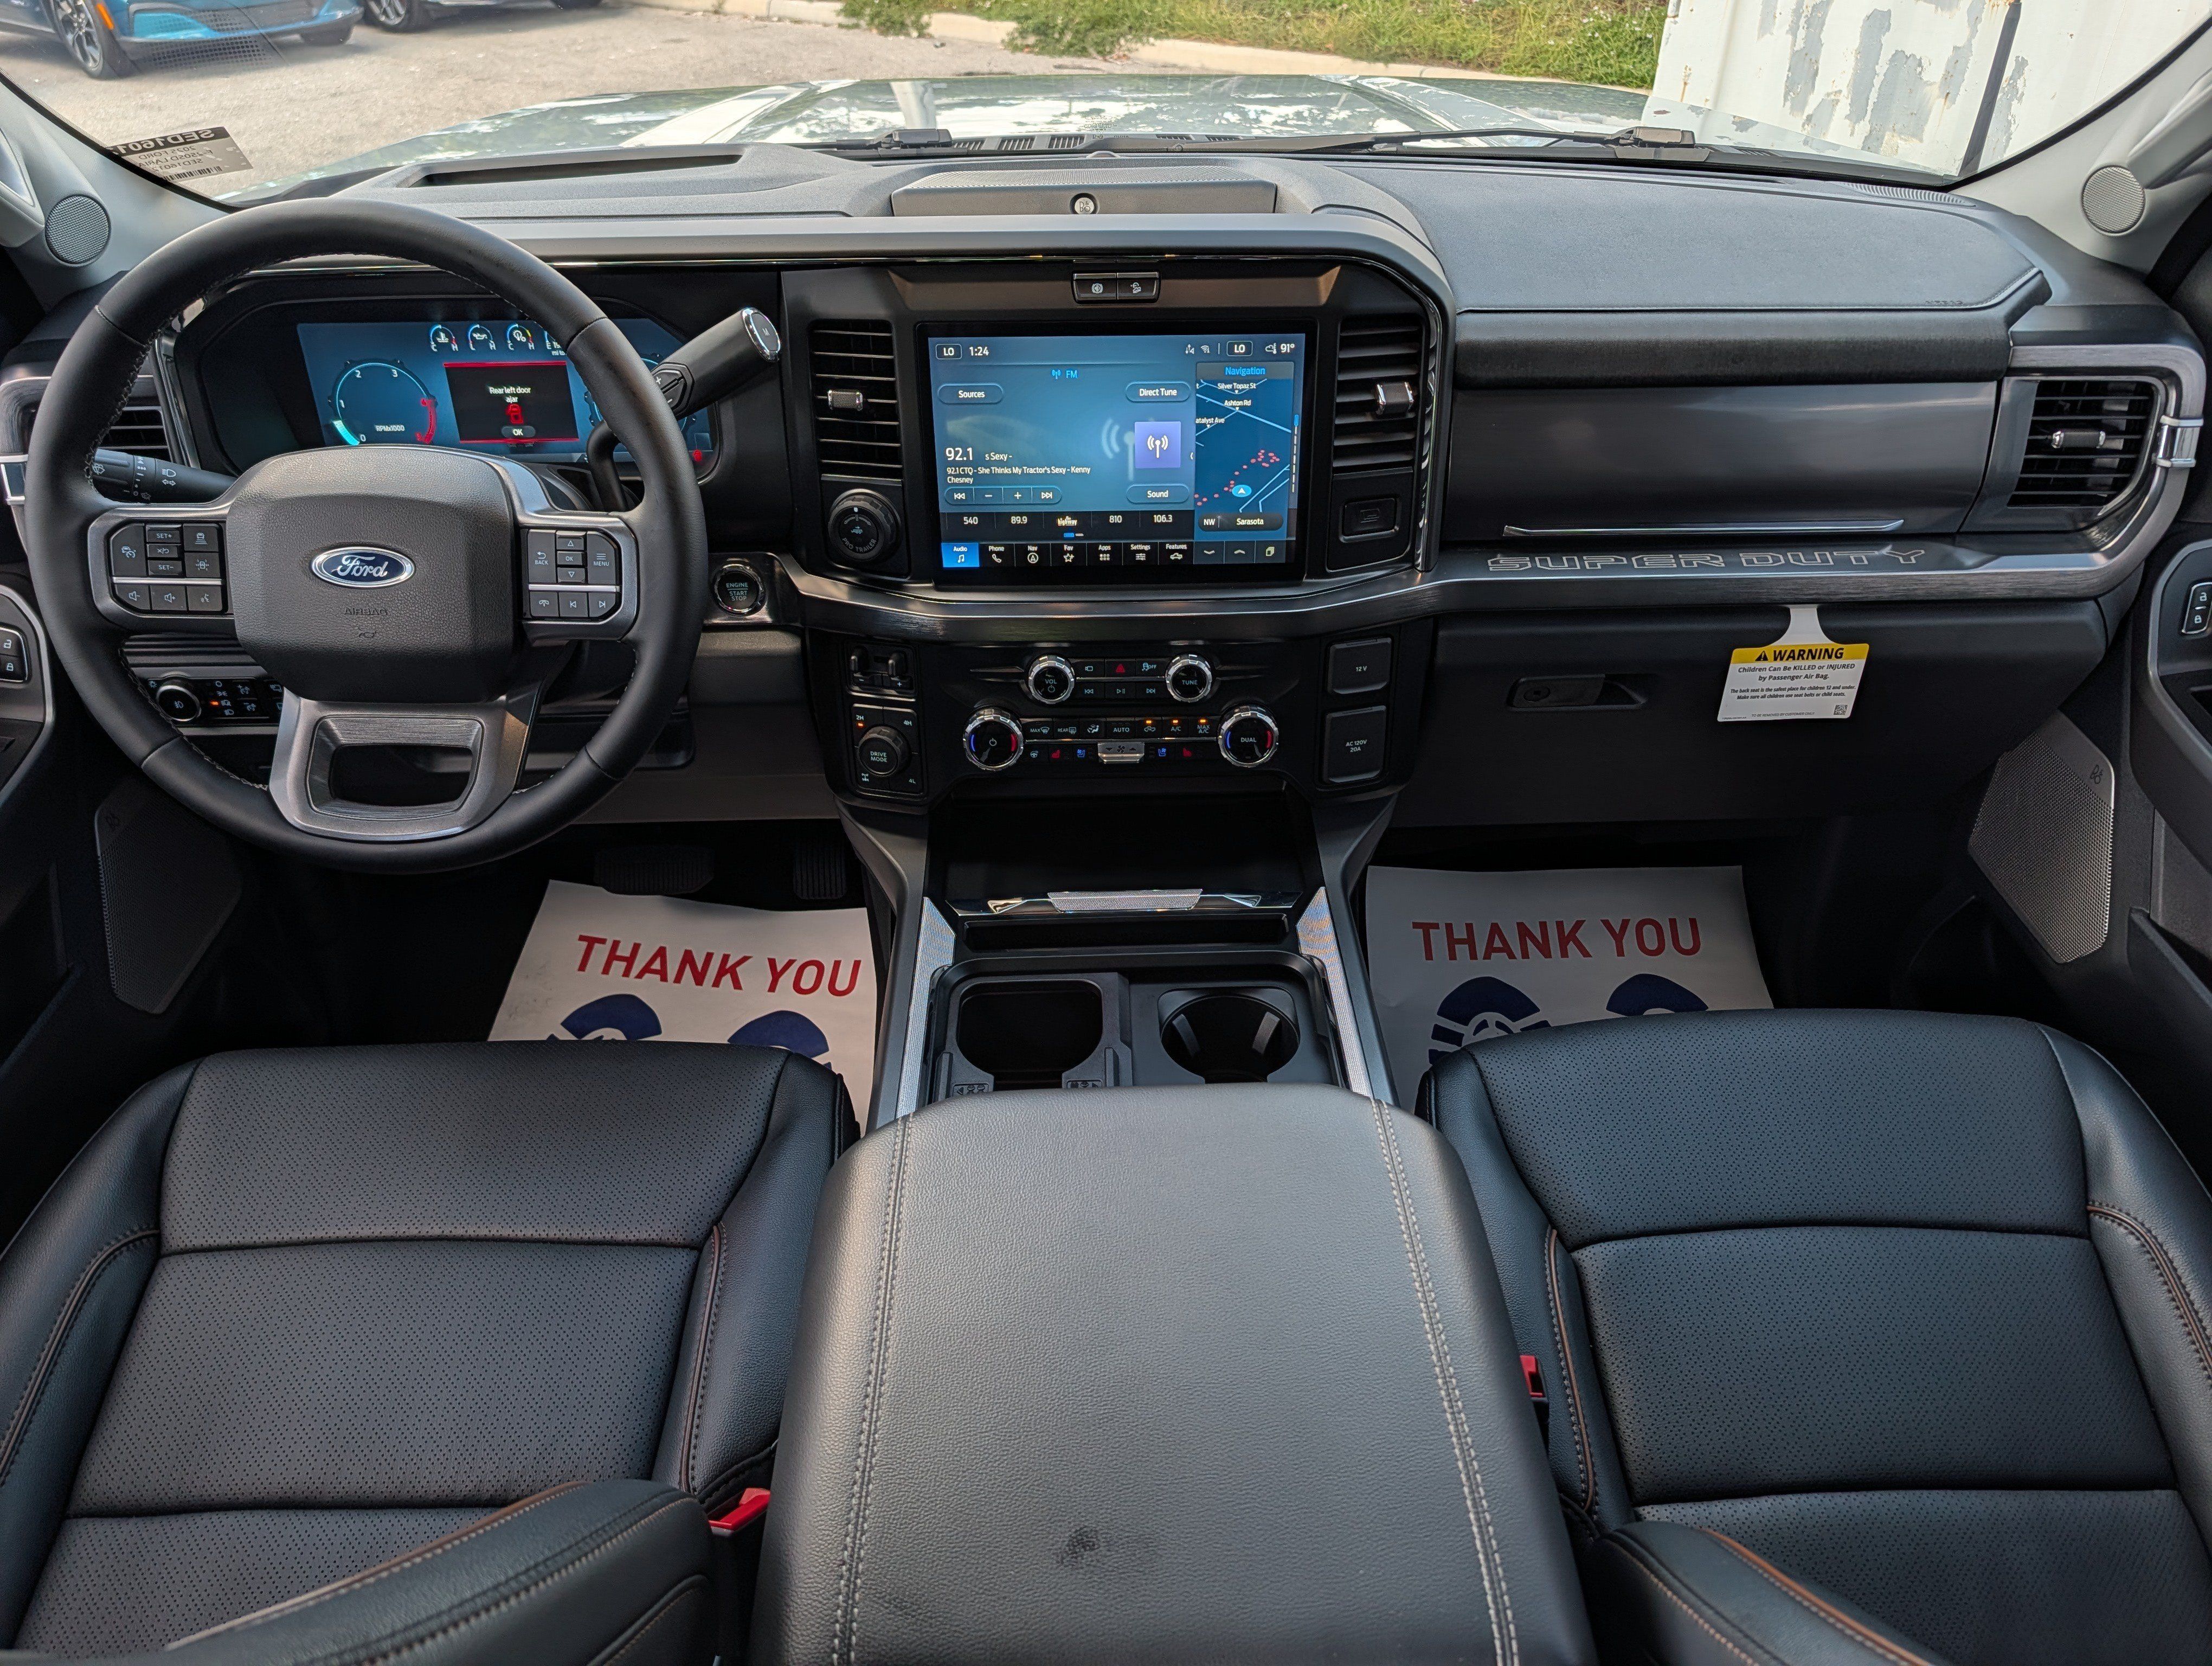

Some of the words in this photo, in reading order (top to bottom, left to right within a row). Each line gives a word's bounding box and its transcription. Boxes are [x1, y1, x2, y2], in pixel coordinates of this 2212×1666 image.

[943, 347, 954, 356] LO
[969, 347, 989, 356] 1:24
[1234, 344, 1245, 353] LO
[355, 369, 362, 379] 2
[391, 369, 398, 377] 3
[1065, 370, 1078, 379] FM
[1225, 367, 1266, 376] Navigation
[489, 386, 504, 394] Rear
[504, 386, 516, 394] left
[516, 386, 531, 394] door
[1160, 388, 1177, 396] Tune
[946, 447, 973, 460] 92.1
[990, 452, 1008, 462] Sexy
[1013, 467, 1023, 475] My
[1051, 466, 1066, 475] Sexy
[1071, 466, 1090, 475] Kenny
[947, 476, 973, 484] Chesney
[1011, 516, 1027, 524] 89.9
[1154, 515, 1172, 523] 106.3
[842, 537, 853, 549] PRO
[856, 539, 877, 553] TRAILER
[1487, 554, 1725, 571] SUPER
[1739, 549, 1925, 567] DUTY
[331, 555, 388, 577] Ford
[1773, 648, 1844, 661] WARNING
[1412, 919, 1593, 961] THANK
[1600, 918, 1701, 957] YOU
[577, 934, 753, 990] THANK
[767, 957, 861, 997] YOU
